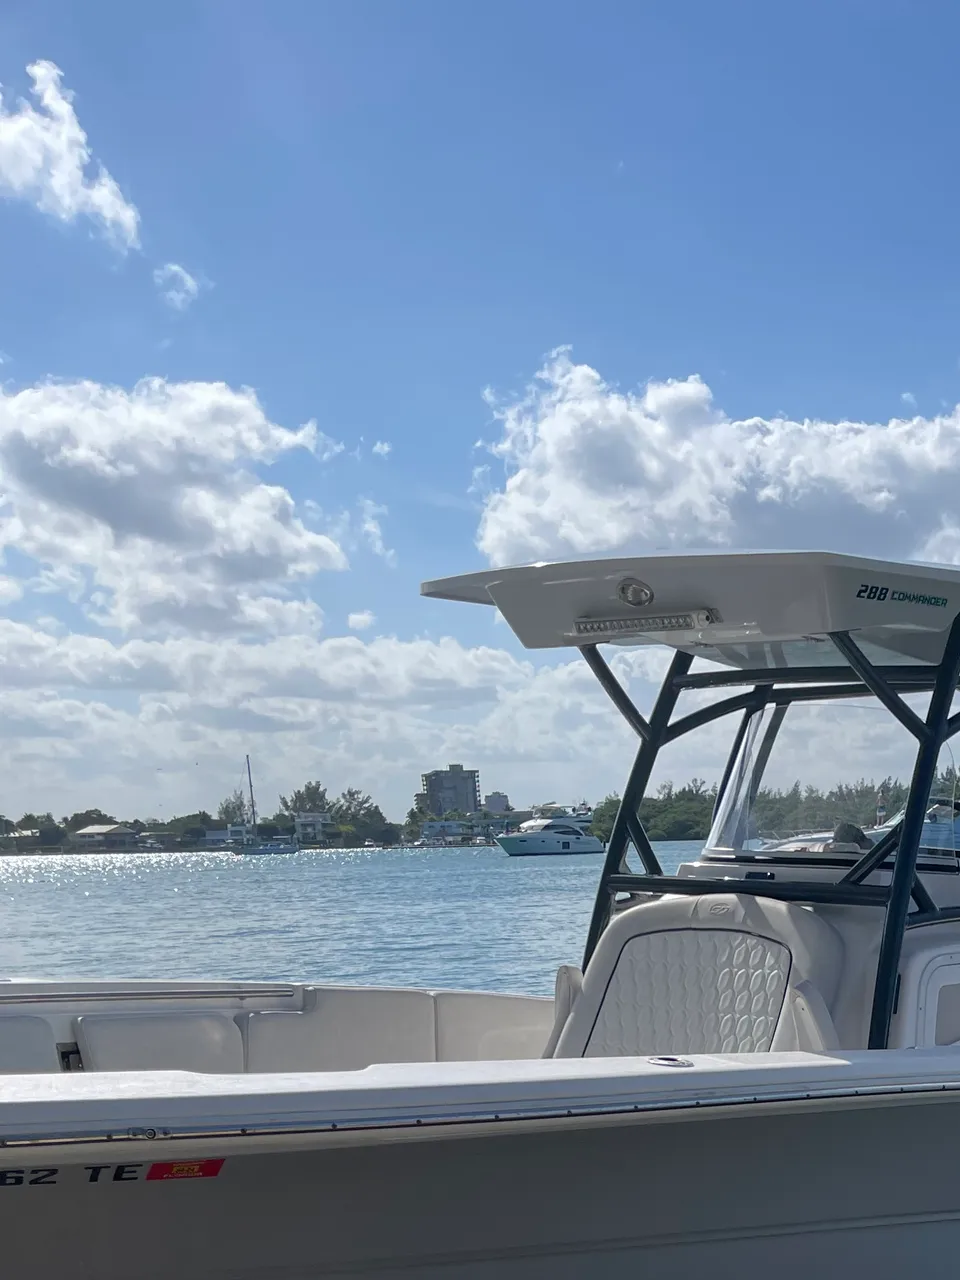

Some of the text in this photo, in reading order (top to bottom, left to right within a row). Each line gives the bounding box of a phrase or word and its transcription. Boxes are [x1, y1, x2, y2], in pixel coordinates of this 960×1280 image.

[856, 584, 948, 607] 288 COMMANDER
[0, 1164, 143, 1186] 62 TE
